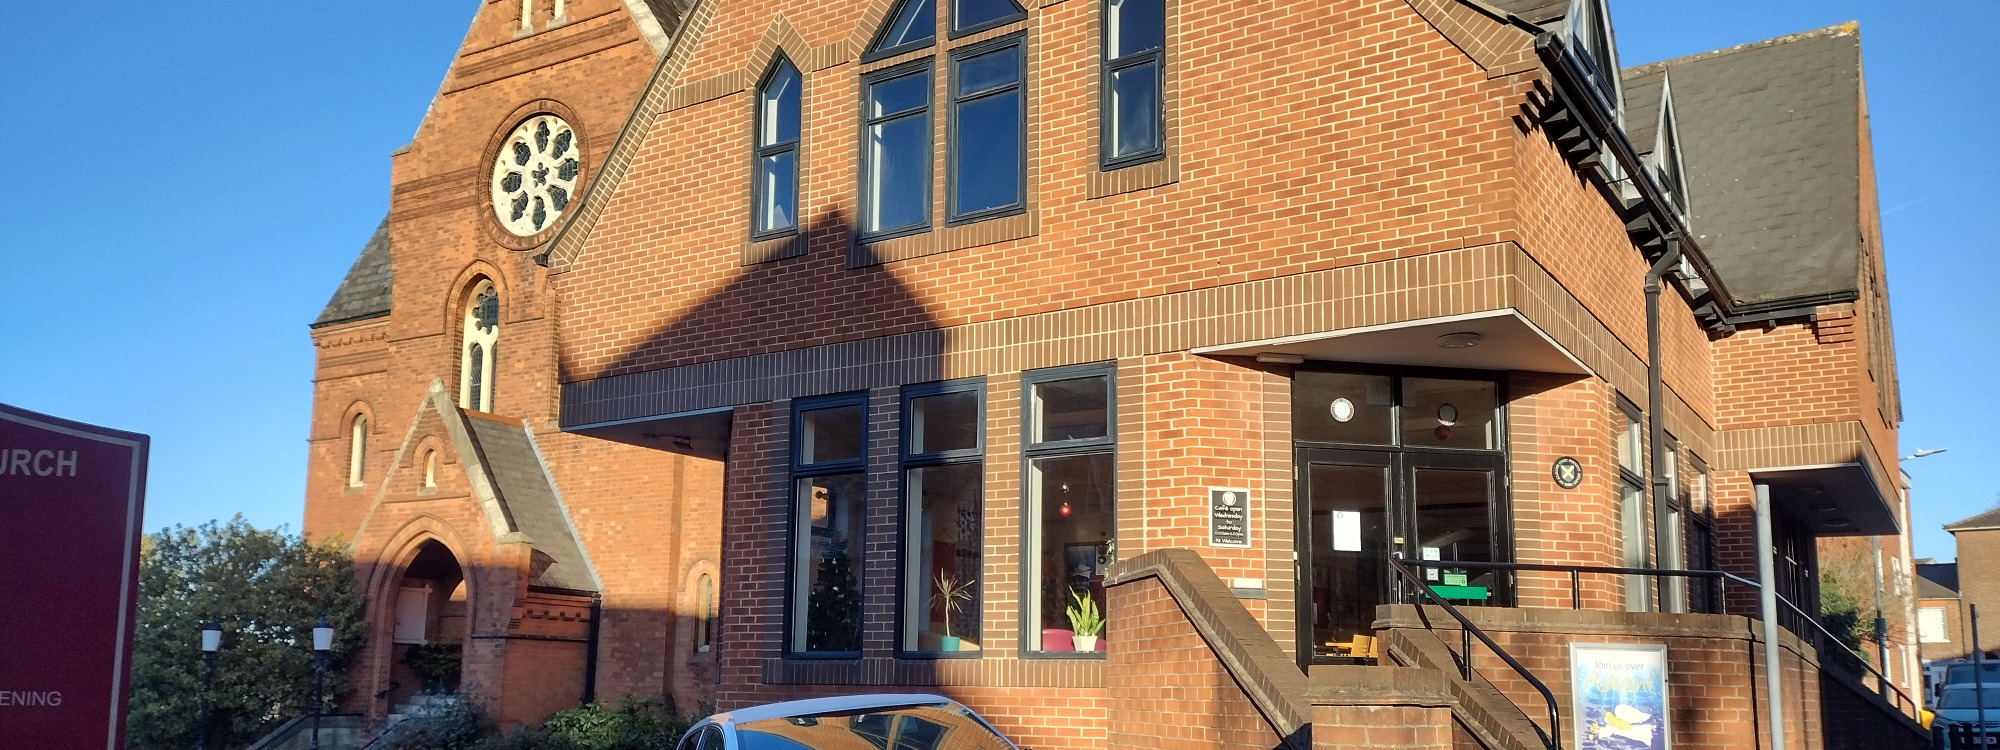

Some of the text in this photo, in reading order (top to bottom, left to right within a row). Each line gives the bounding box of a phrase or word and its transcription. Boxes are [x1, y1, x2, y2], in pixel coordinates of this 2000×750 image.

[1214, 512, 1243, 521] Wednesday
[1595, 661, 1612, 670] Join
[1625, 663, 1644, 671] over
[1585, 669, 1655, 693] Advent
[0, 690, 62, 706] ENING
